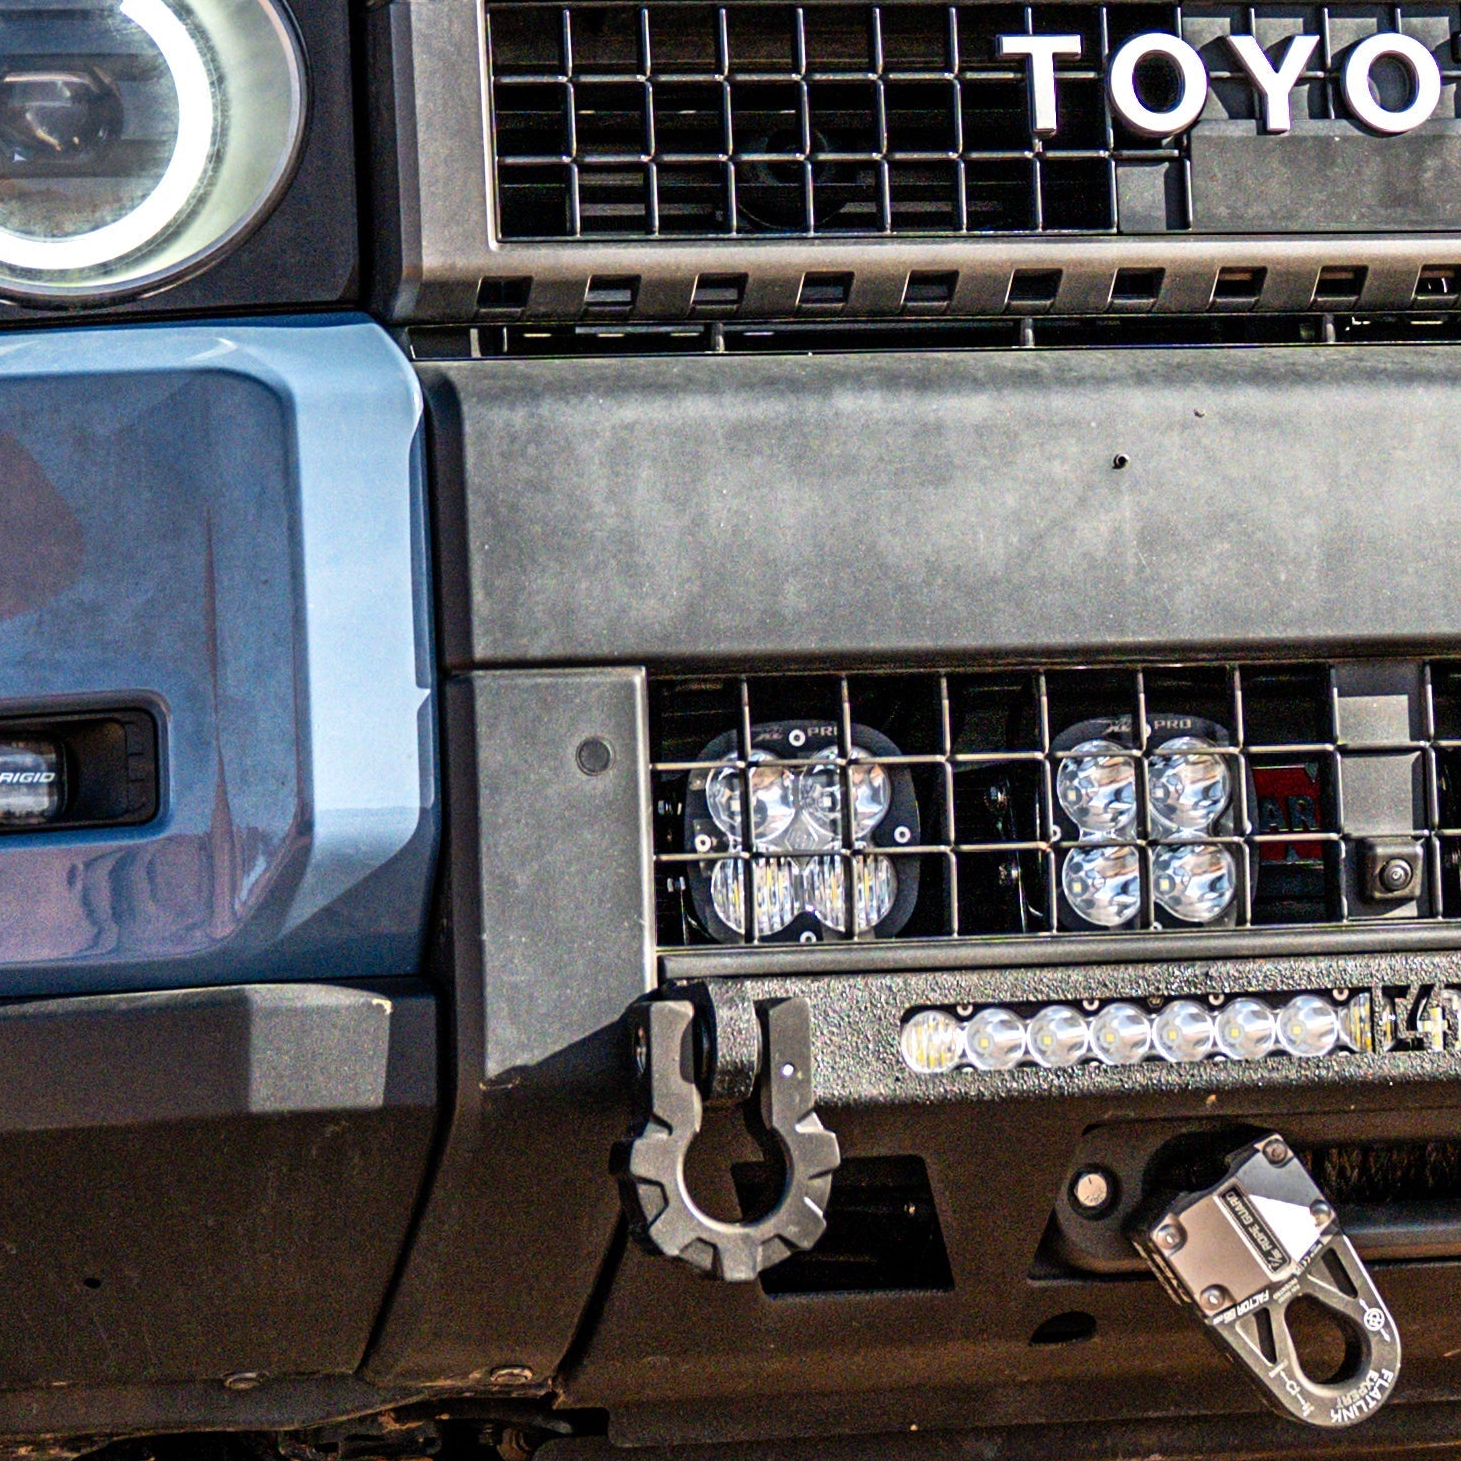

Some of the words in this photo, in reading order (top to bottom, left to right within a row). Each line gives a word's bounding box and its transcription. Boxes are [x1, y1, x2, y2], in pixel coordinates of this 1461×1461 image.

[1154, 719, 1192, 730] PRO
[1225, 1191, 1254, 1226] GUARD
[1248, 1224, 1273, 1252] ROPE
[1236, 1289, 1270, 1316] FACTOR
[1330, 1368, 1394, 1423] FLATLINK
[1336, 1369, 1379, 1409] EXPERT
